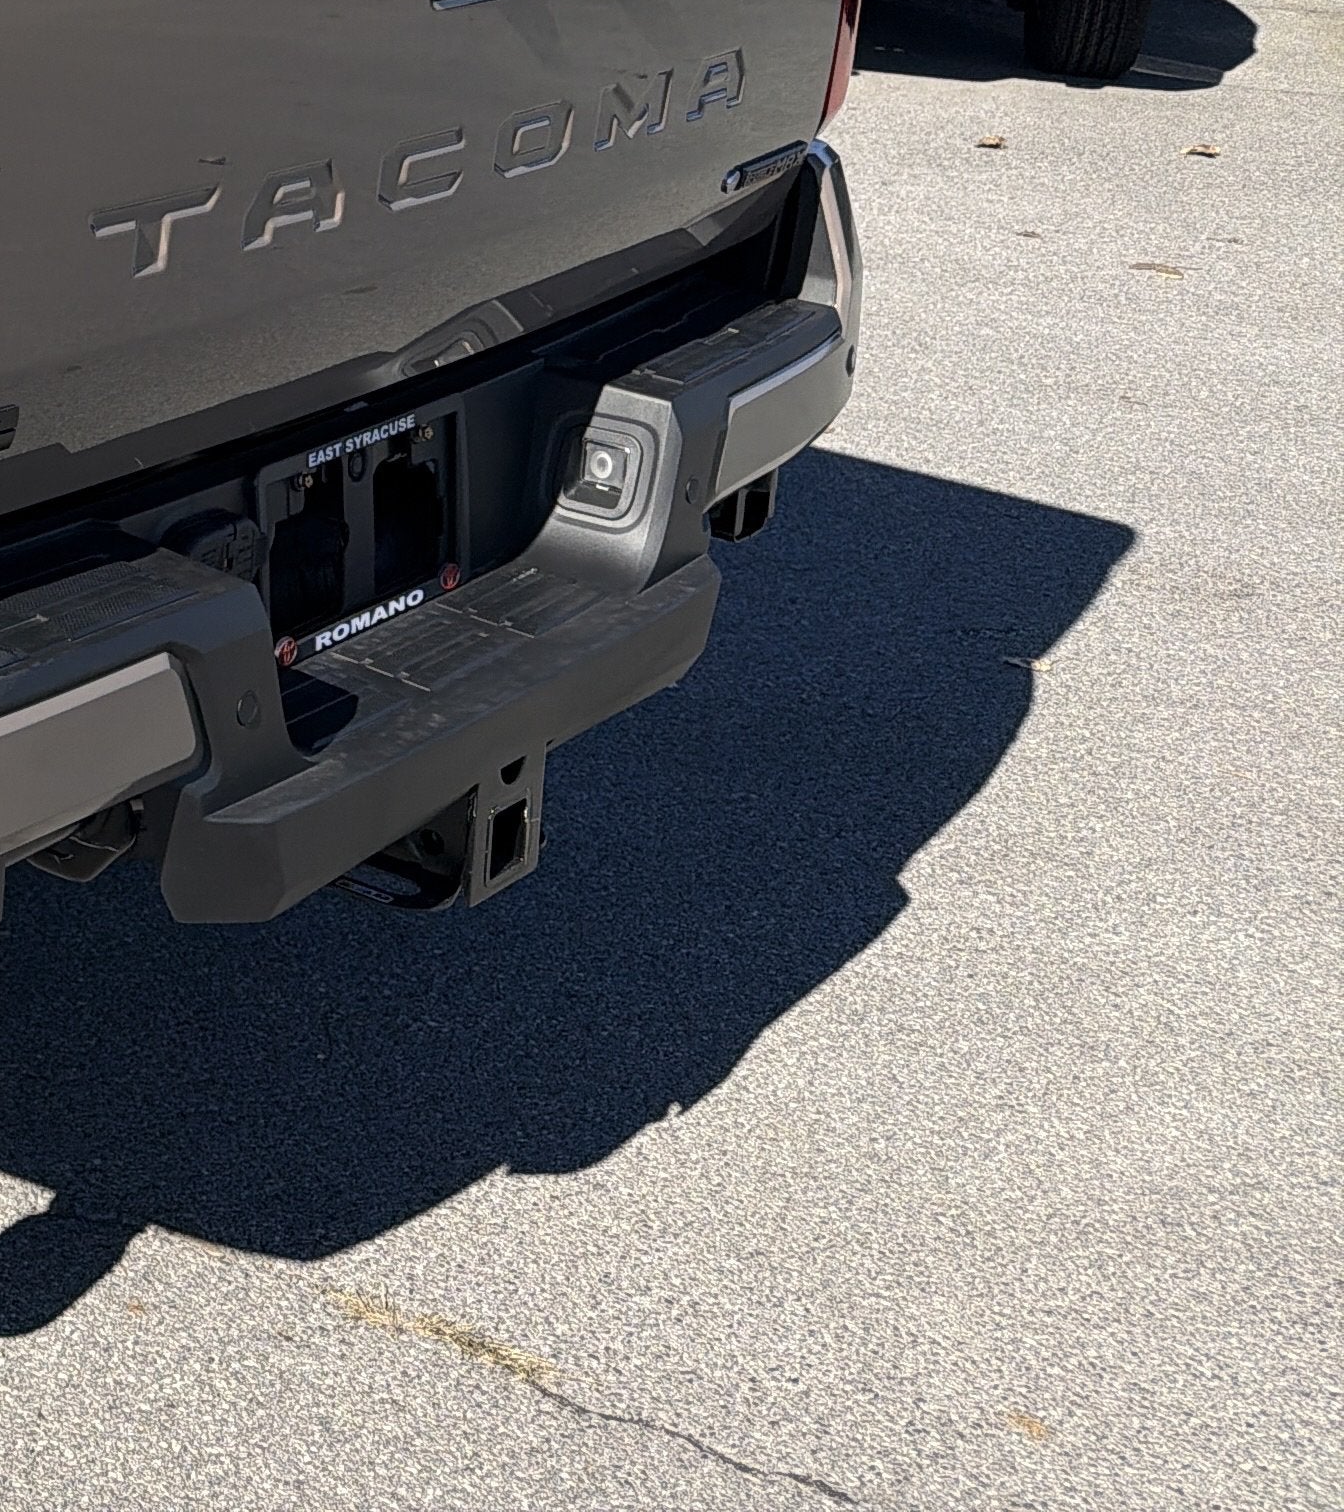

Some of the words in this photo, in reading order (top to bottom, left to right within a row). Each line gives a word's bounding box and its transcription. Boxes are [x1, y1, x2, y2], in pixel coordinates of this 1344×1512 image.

[89, 48, 744, 279] TACOMA
[308, 442, 343, 468] EAST
[345, 413, 416, 454] SYRACUSE
[315, 588, 425, 652] ROMANO
